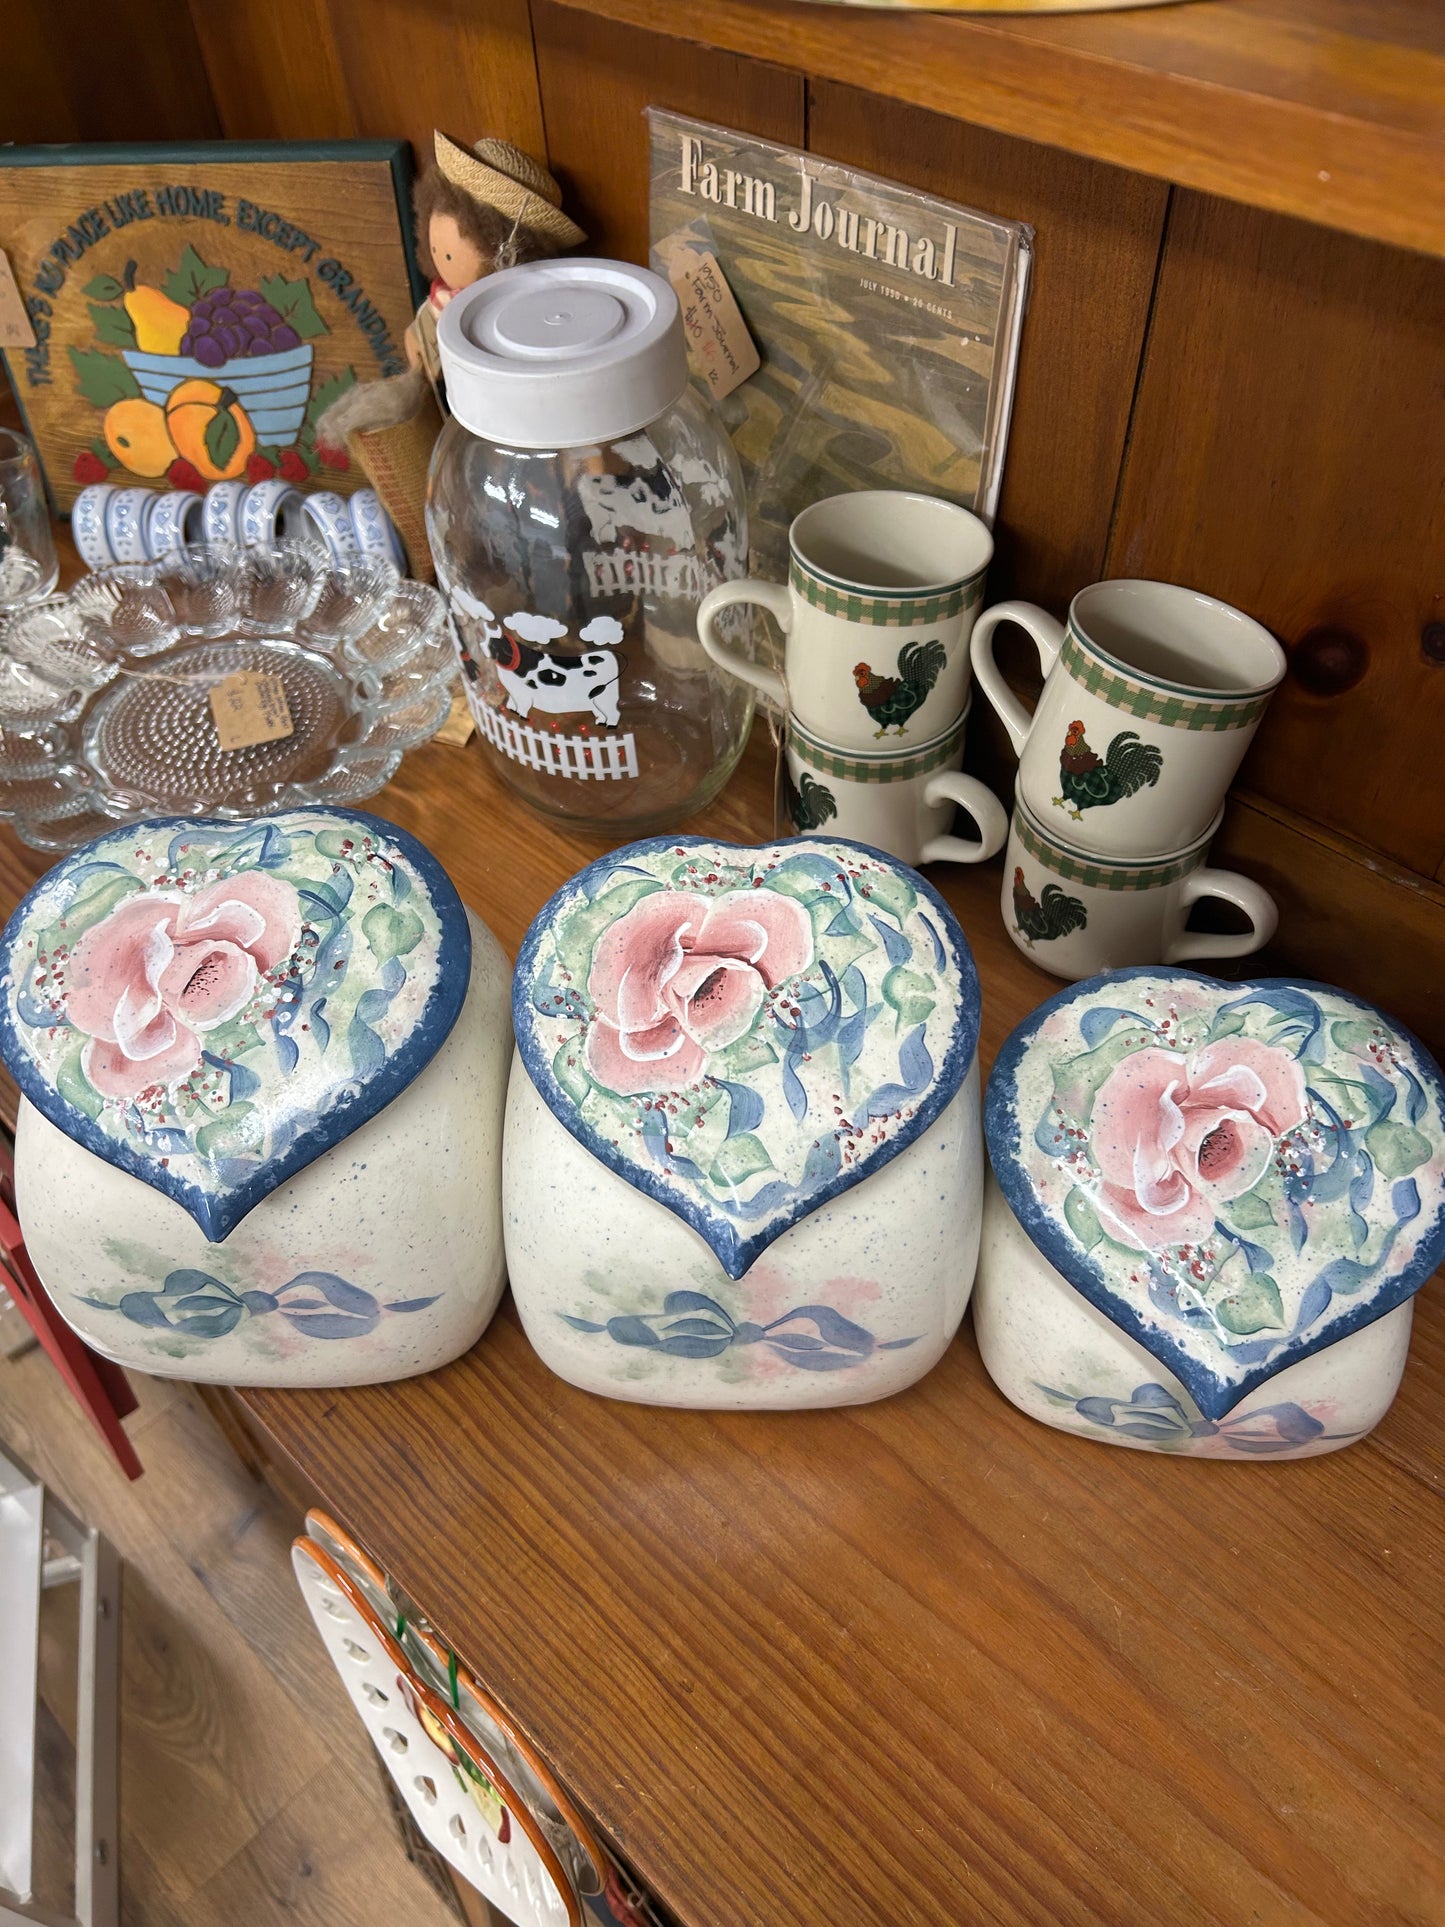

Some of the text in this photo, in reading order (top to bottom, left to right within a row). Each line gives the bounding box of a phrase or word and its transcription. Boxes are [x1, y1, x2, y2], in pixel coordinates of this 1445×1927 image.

[33, 259, 65, 299] NO
[51, 207, 111, 269] PLACE
[103, 188, 155, 230] LIKE
[236, 199, 321, 264] EXCEPT
[677, 133, 958, 288] Farm Journal
[692, 276, 740, 375] Farm Journal
[699, 262, 722, 303] 1950
[860, 278, 878, 292] JULY
[881, 285, 901, 301] 1950
[926, 302, 953, 320] CENTS
